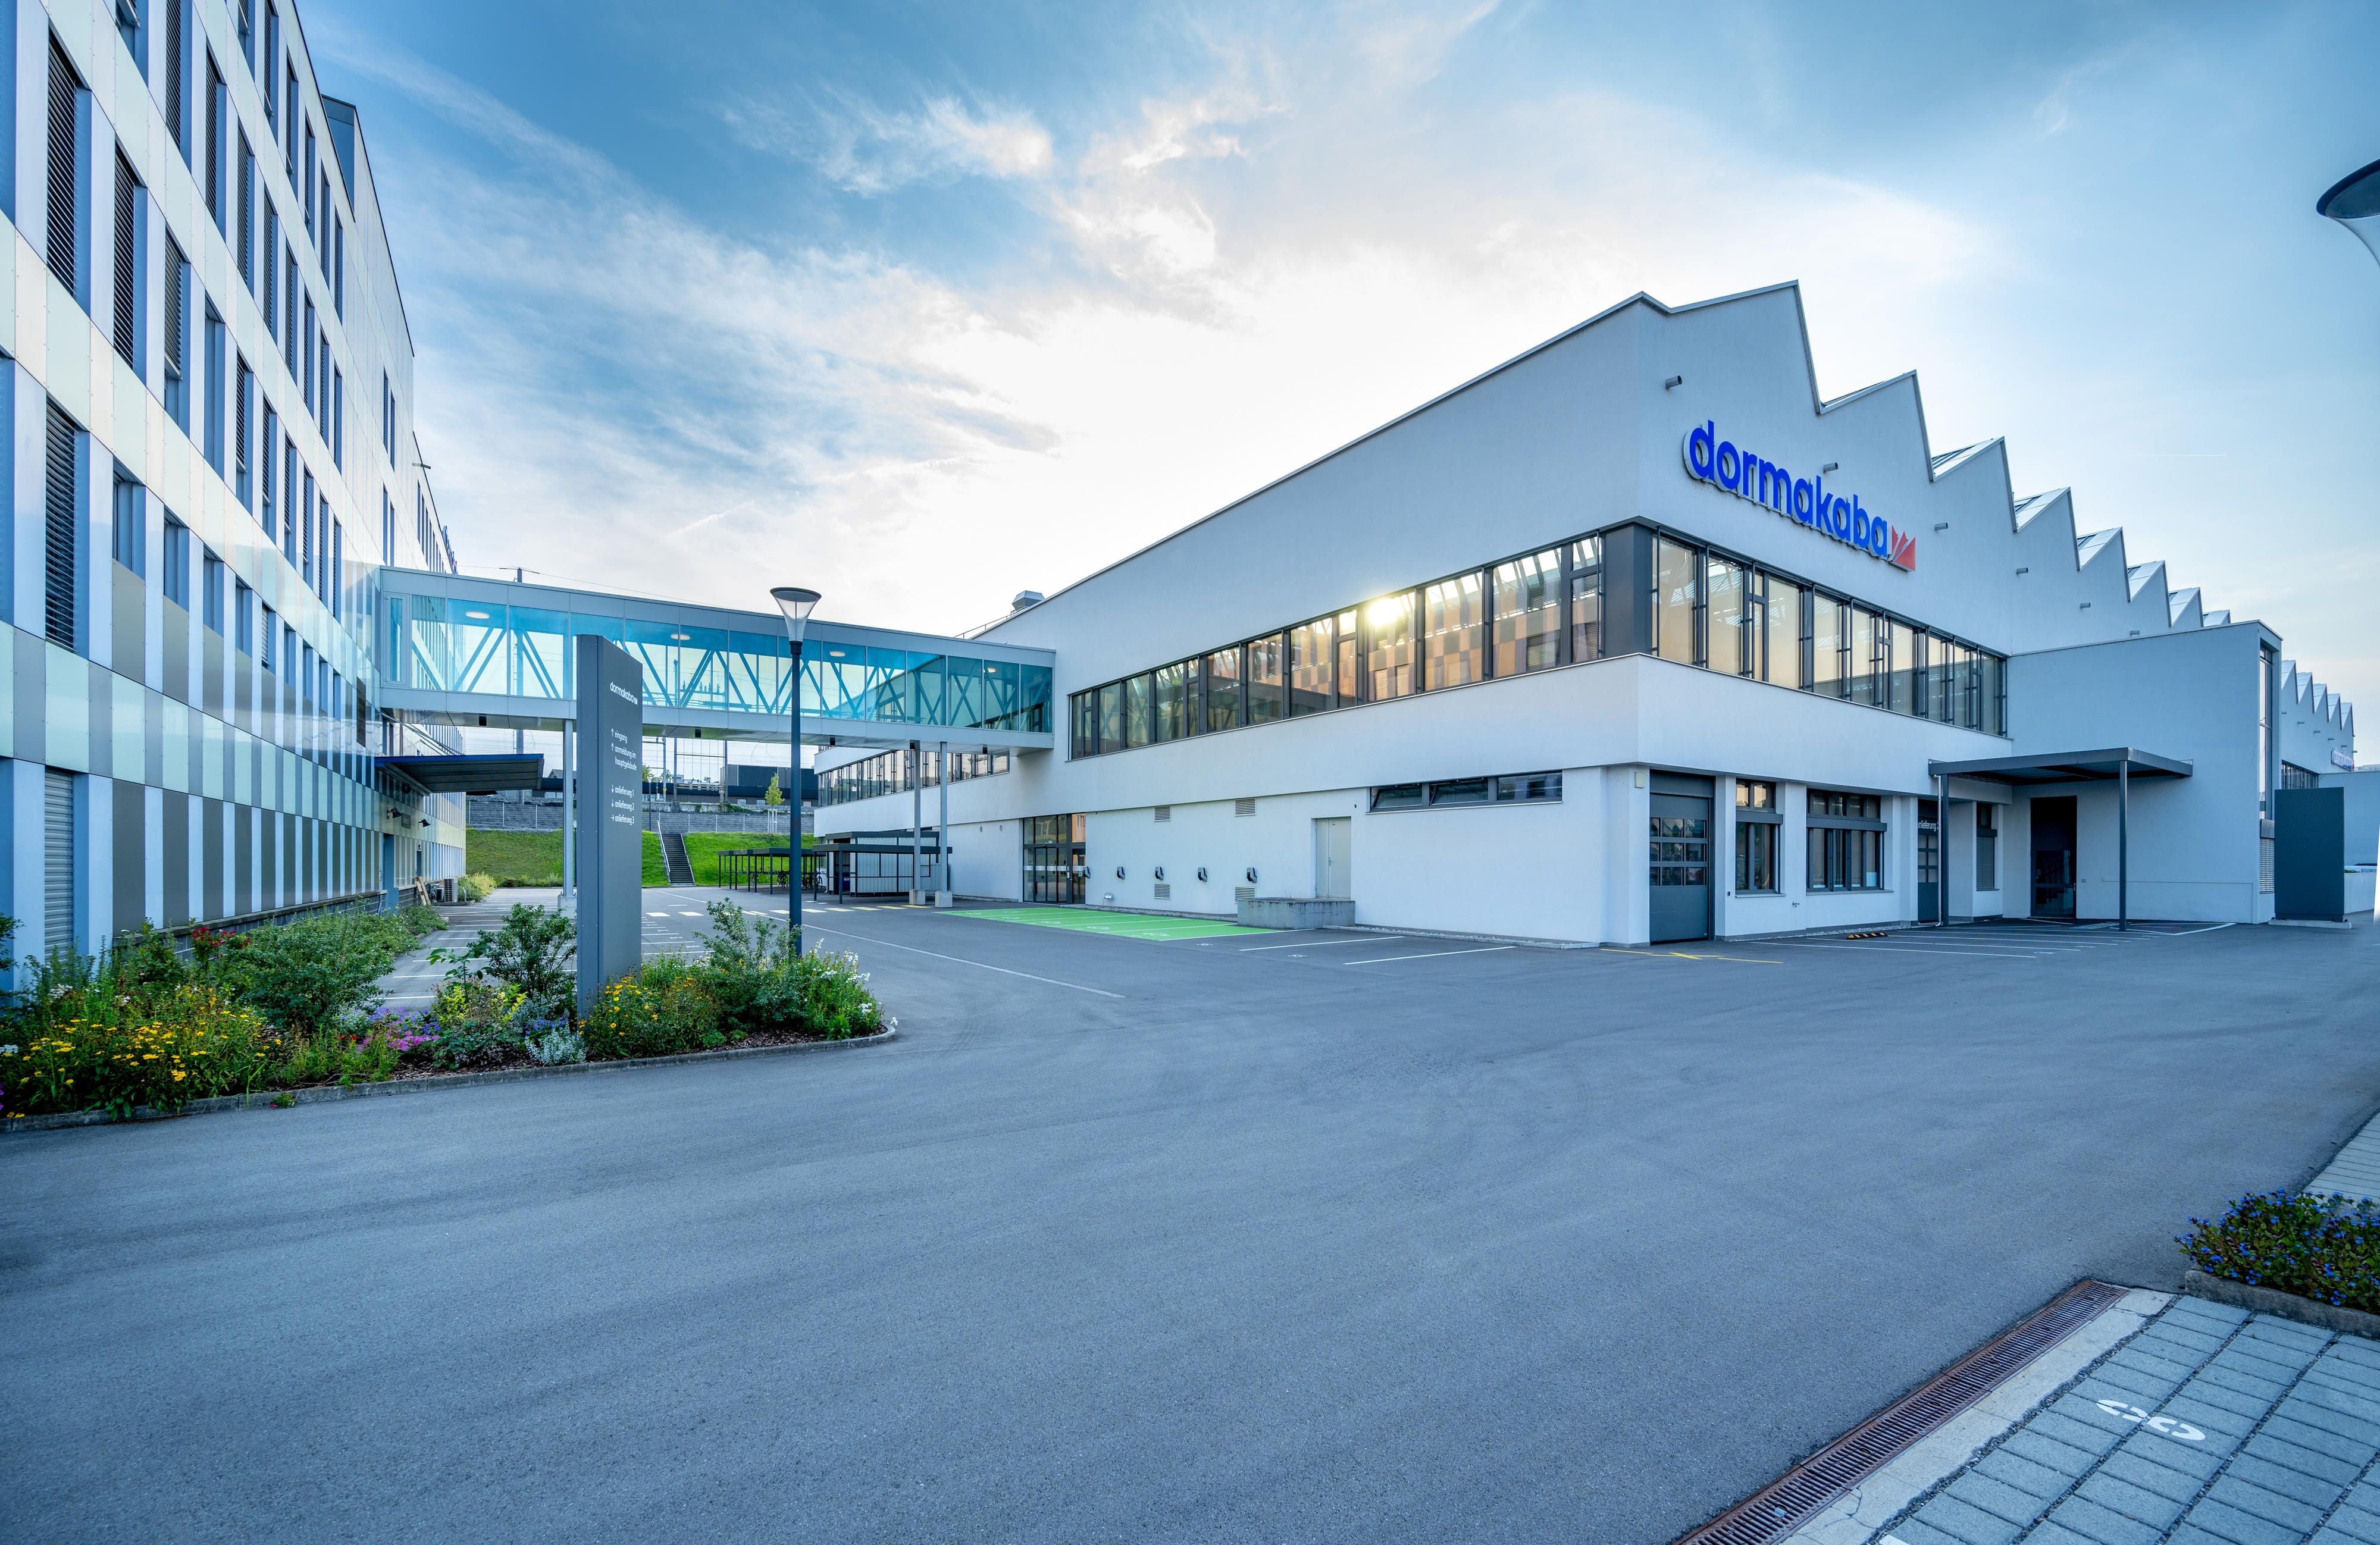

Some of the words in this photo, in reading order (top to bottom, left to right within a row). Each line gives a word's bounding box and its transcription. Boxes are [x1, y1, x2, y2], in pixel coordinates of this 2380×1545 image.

[1684, 419, 1888, 559] dormakaba
[610, 681, 634, 703] dormakaba
[615, 730, 628, 744] eingang
[615, 746, 632, 759] anmeldung
[632, 750, 637, 759] im
[615, 756, 637, 771] hauptgebäude
[615, 785, 632, 798] anlieferung
[615, 800, 632, 812] anlieferung
[615, 814, 632, 826] anlieferung
